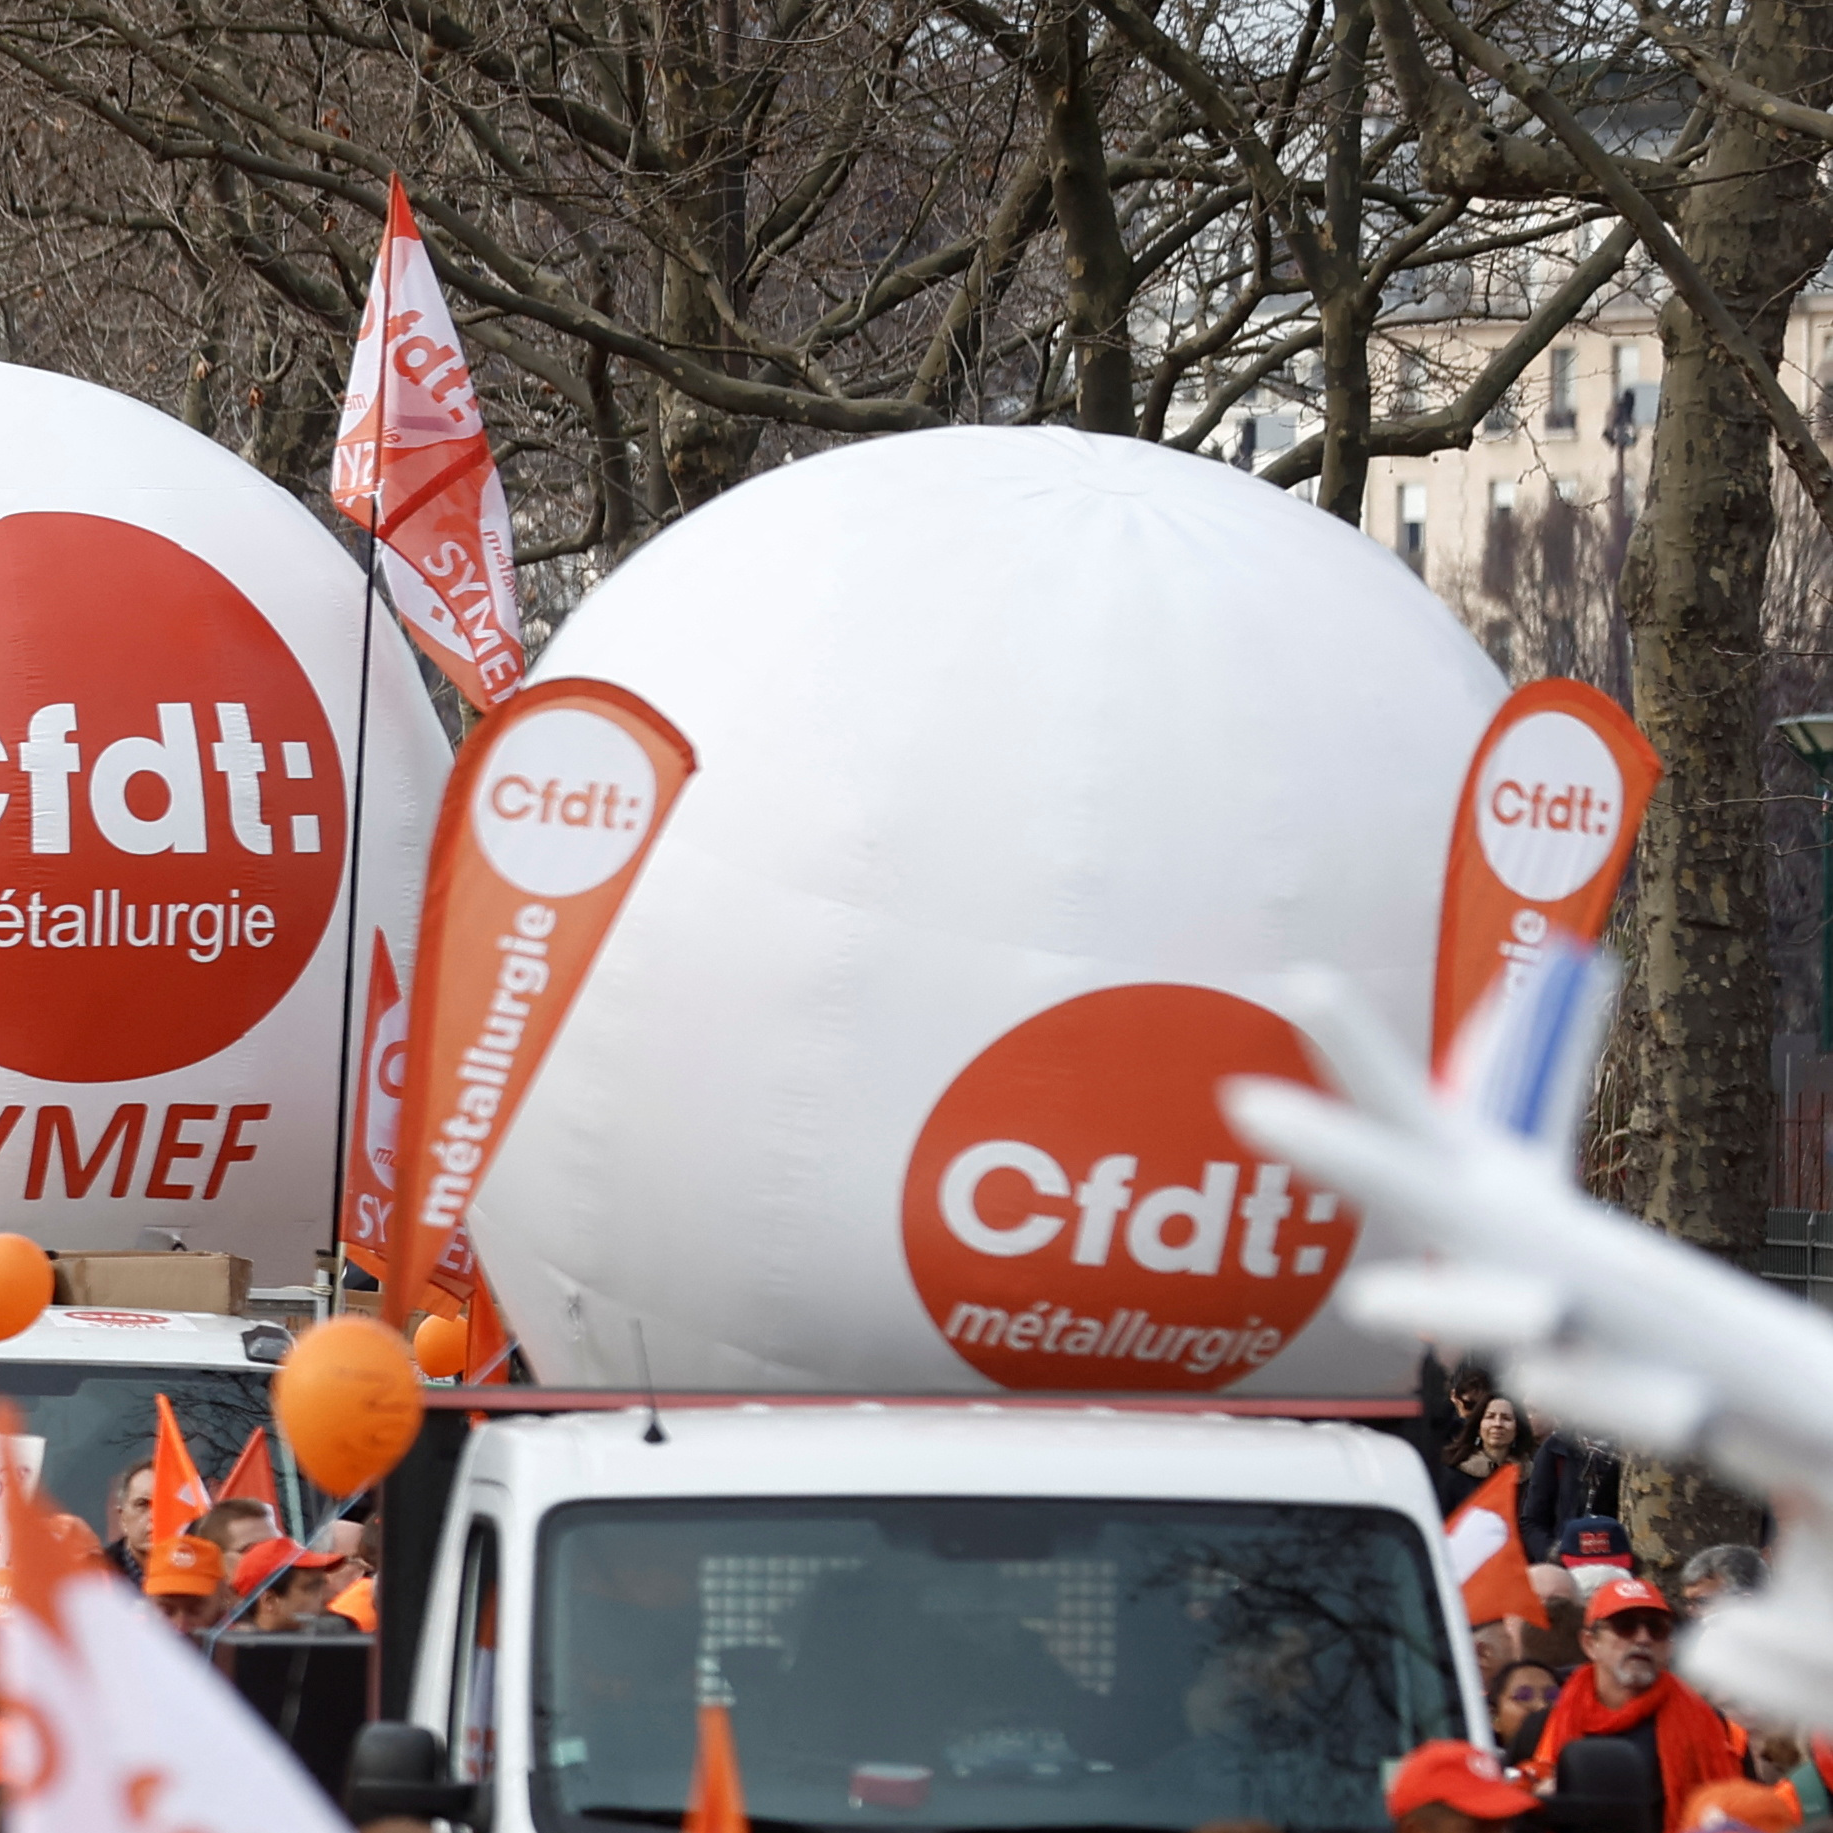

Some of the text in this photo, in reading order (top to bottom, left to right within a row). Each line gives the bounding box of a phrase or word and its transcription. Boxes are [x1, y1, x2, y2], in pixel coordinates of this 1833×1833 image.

[491, 775, 643, 831] Cfdt:
[1492, 780, 1611, 836] Cfdt:
[419, 904, 557, 1228] métallurgie
[937, 1139, 1334, 1277] Cfdt:
[945, 1298, 1283, 1374] métallurgie
